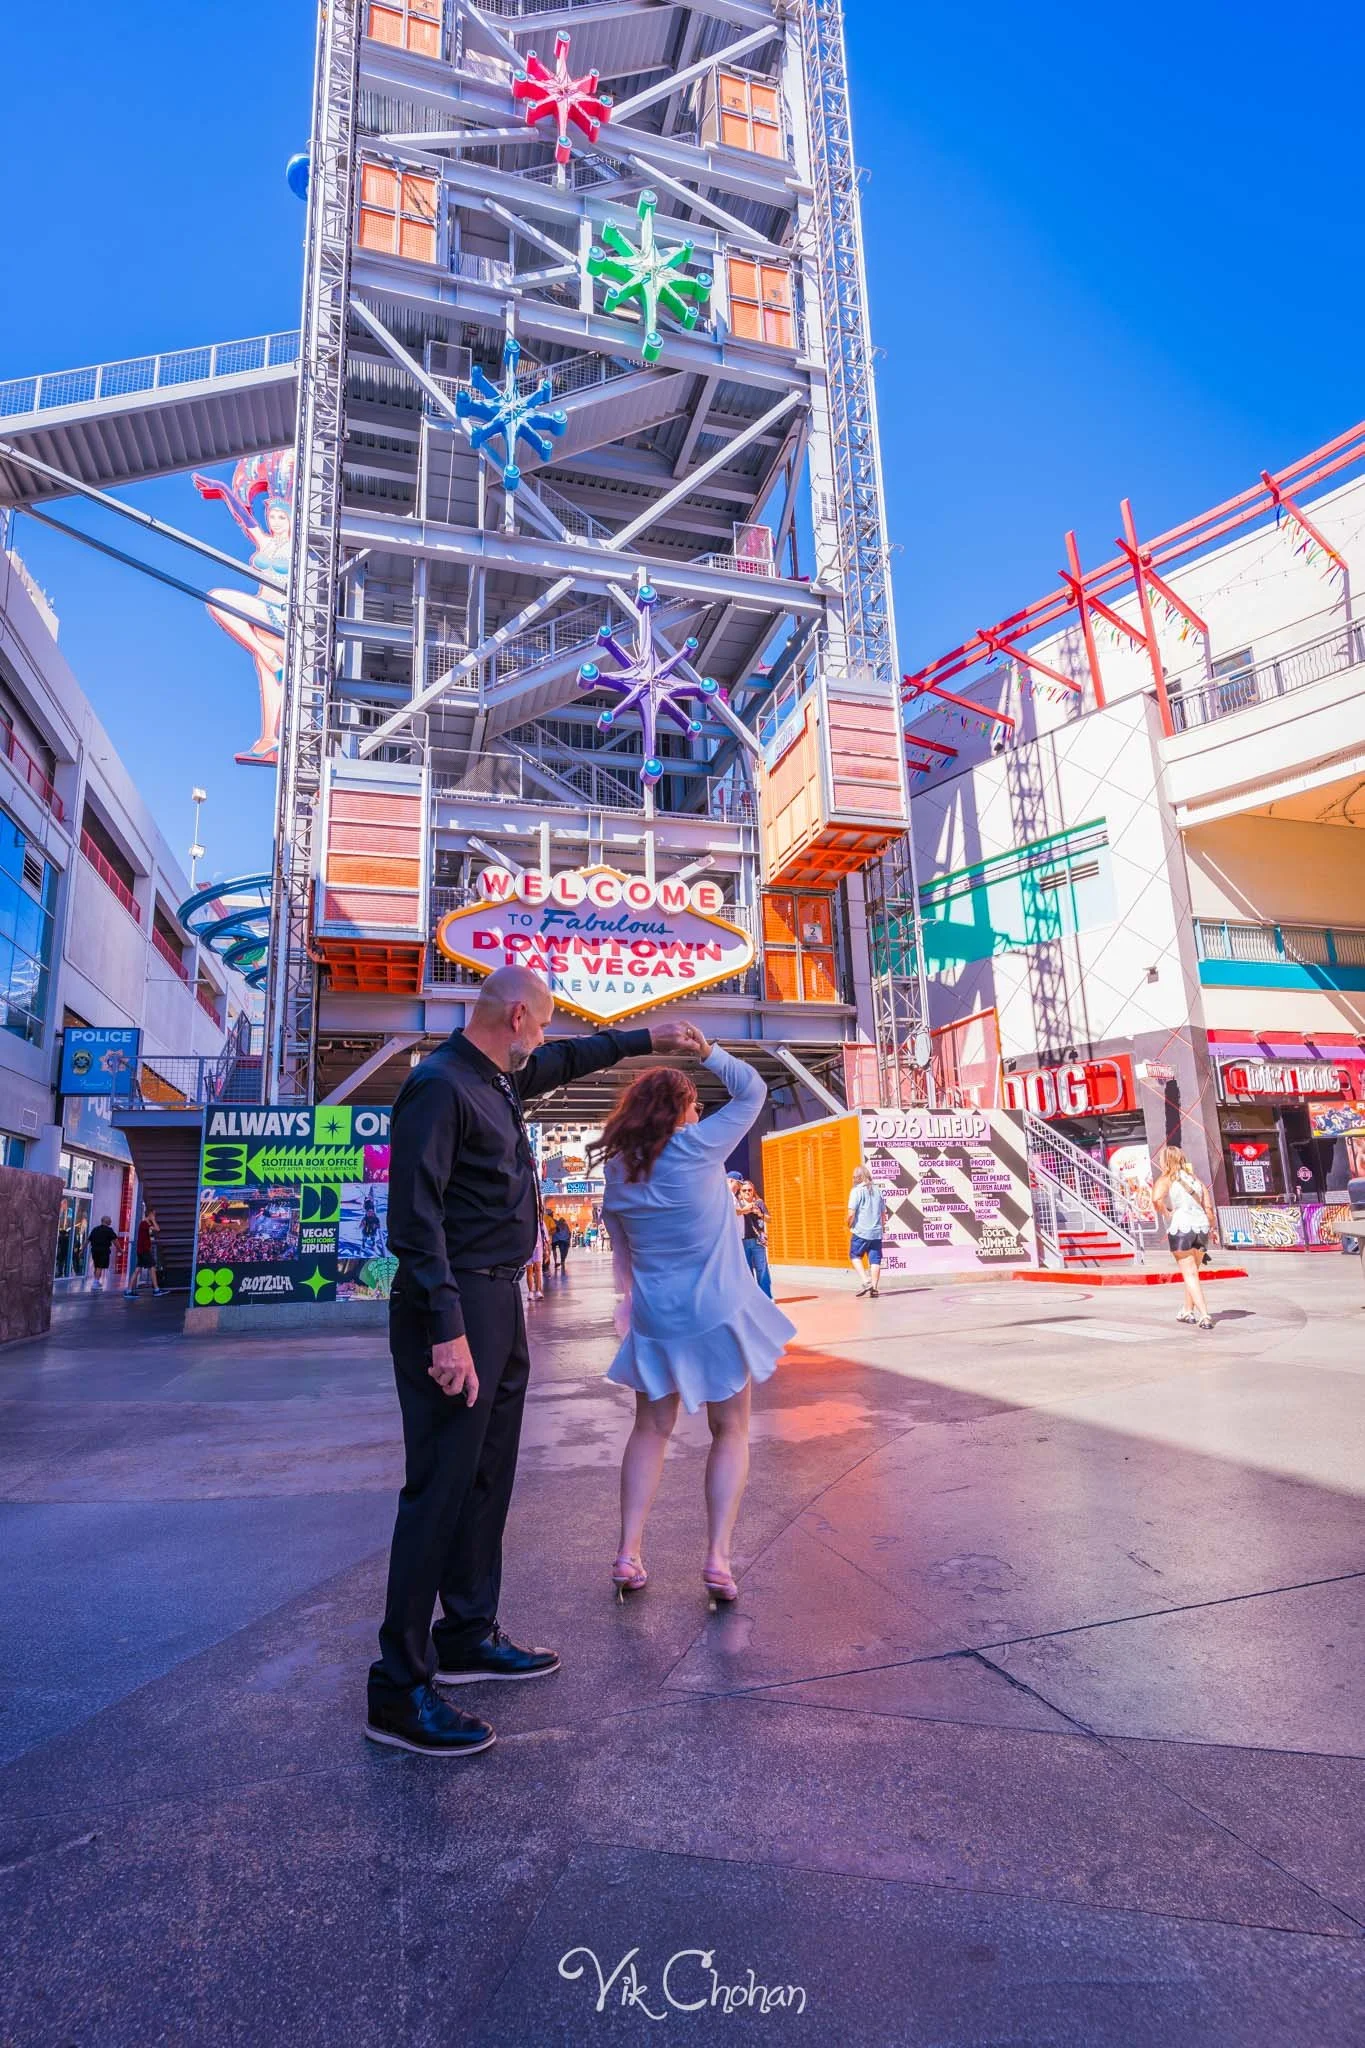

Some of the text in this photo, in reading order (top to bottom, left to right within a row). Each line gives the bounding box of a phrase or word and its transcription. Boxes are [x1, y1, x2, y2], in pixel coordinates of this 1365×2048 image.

[483, 872, 716, 909] WELCOME
[508, 908, 675, 934] TO Fabulous
[809, 926, 817, 936] 2
[472, 930, 722, 961] DOWNTOWN
[581, 956, 697, 978] VEGAS
[551, 978, 653, 994] NEVADA
[71, 1030, 133, 1043] POLICE
[209, 1111, 311, 1137] ALWAYS
[866, 1117, 987, 1139] 2026 LINEUP
[261, 1158, 358, 1167] SLOTZILLA BOX OFFICE
[922, 1203, 969, 1212] MAYDAY PARADE
[943, 1223, 953, 1231] OF
[301, 1243, 336, 1254] ZIPLINE
[977, 1236, 1018, 1249] SUMMER
[889, 1262, 907, 1270] MORE
